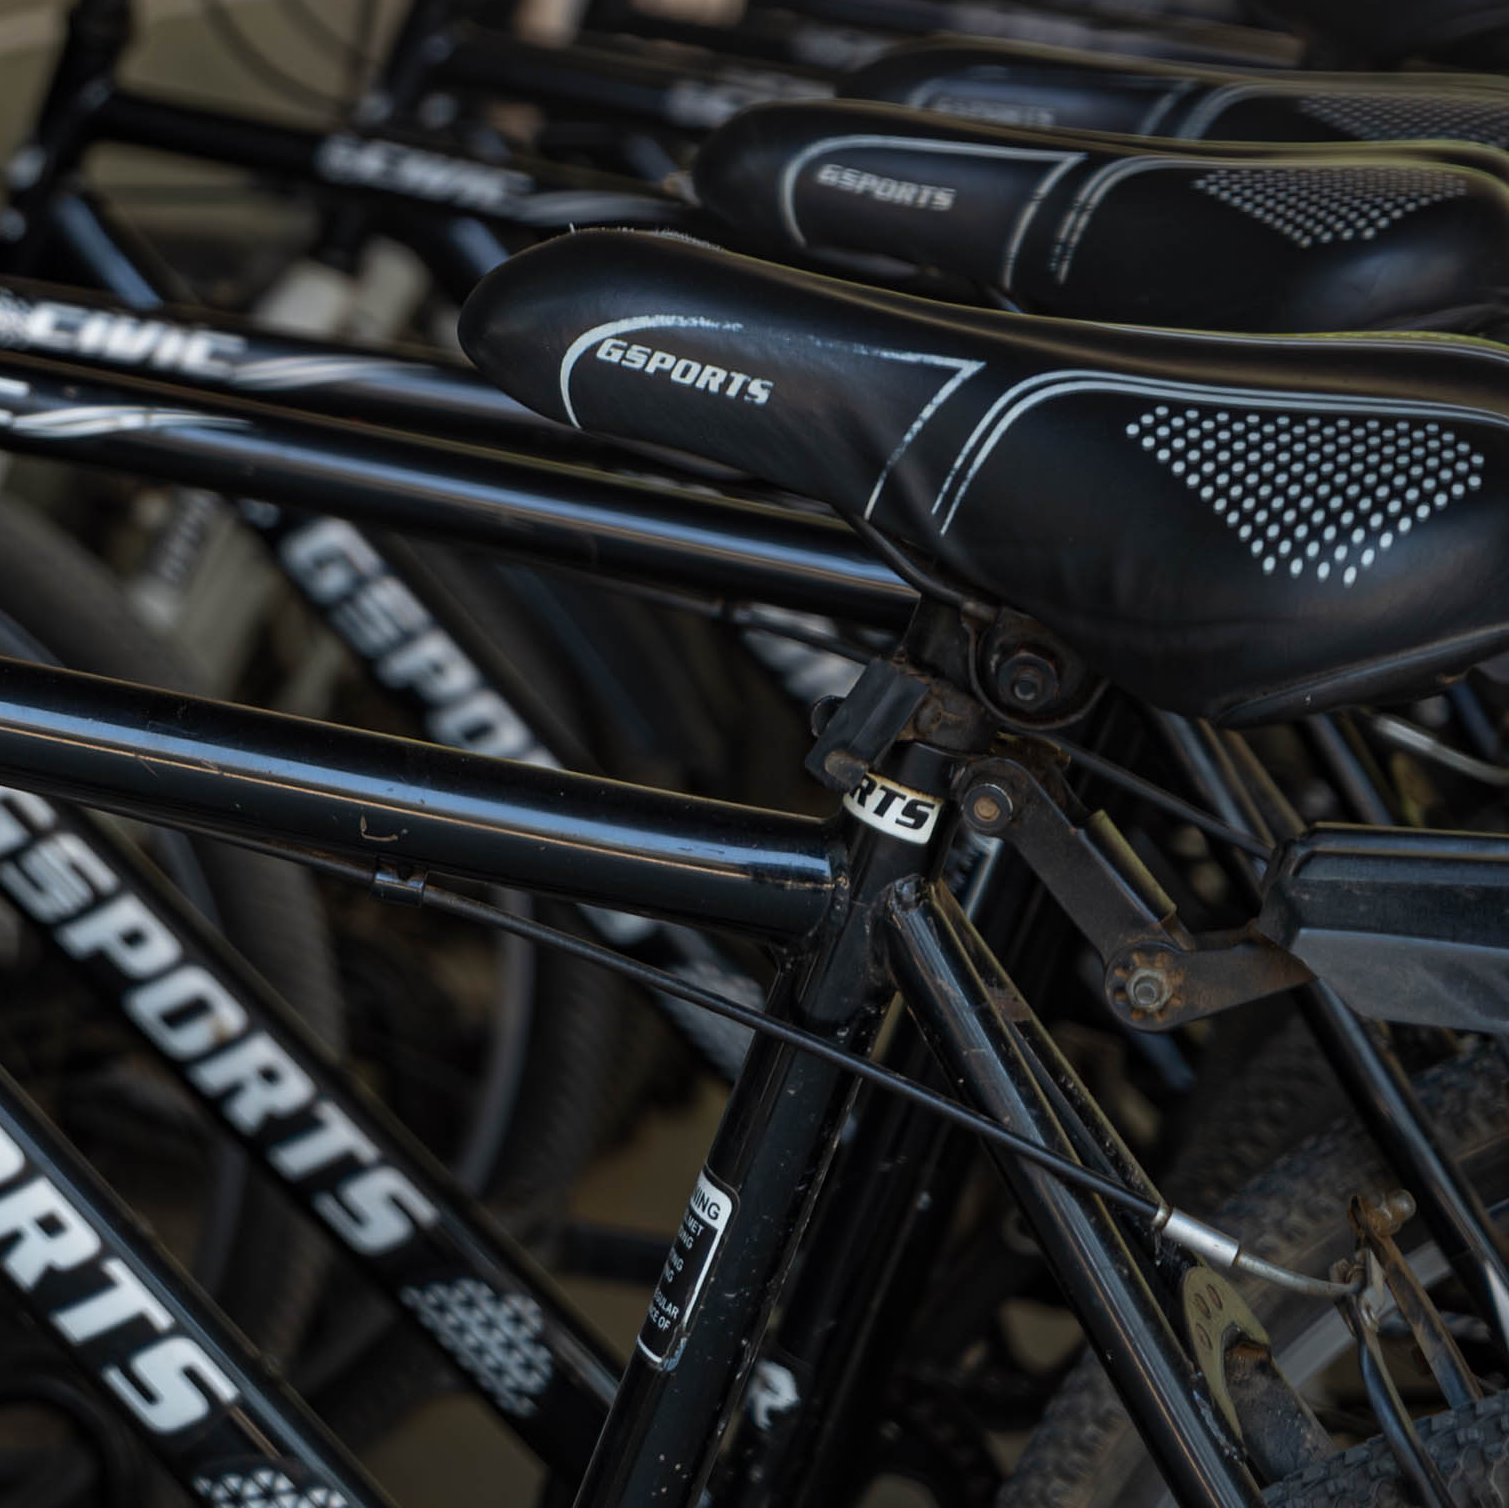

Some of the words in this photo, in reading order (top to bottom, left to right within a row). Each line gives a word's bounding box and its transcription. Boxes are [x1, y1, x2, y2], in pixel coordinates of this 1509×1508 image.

[816, 162, 957, 212] GSPORTS
[25, 304, 246, 382] CIVIC
[595, 338, 773, 408] GSPORTS
[283, 516, 561, 764] GSPO
